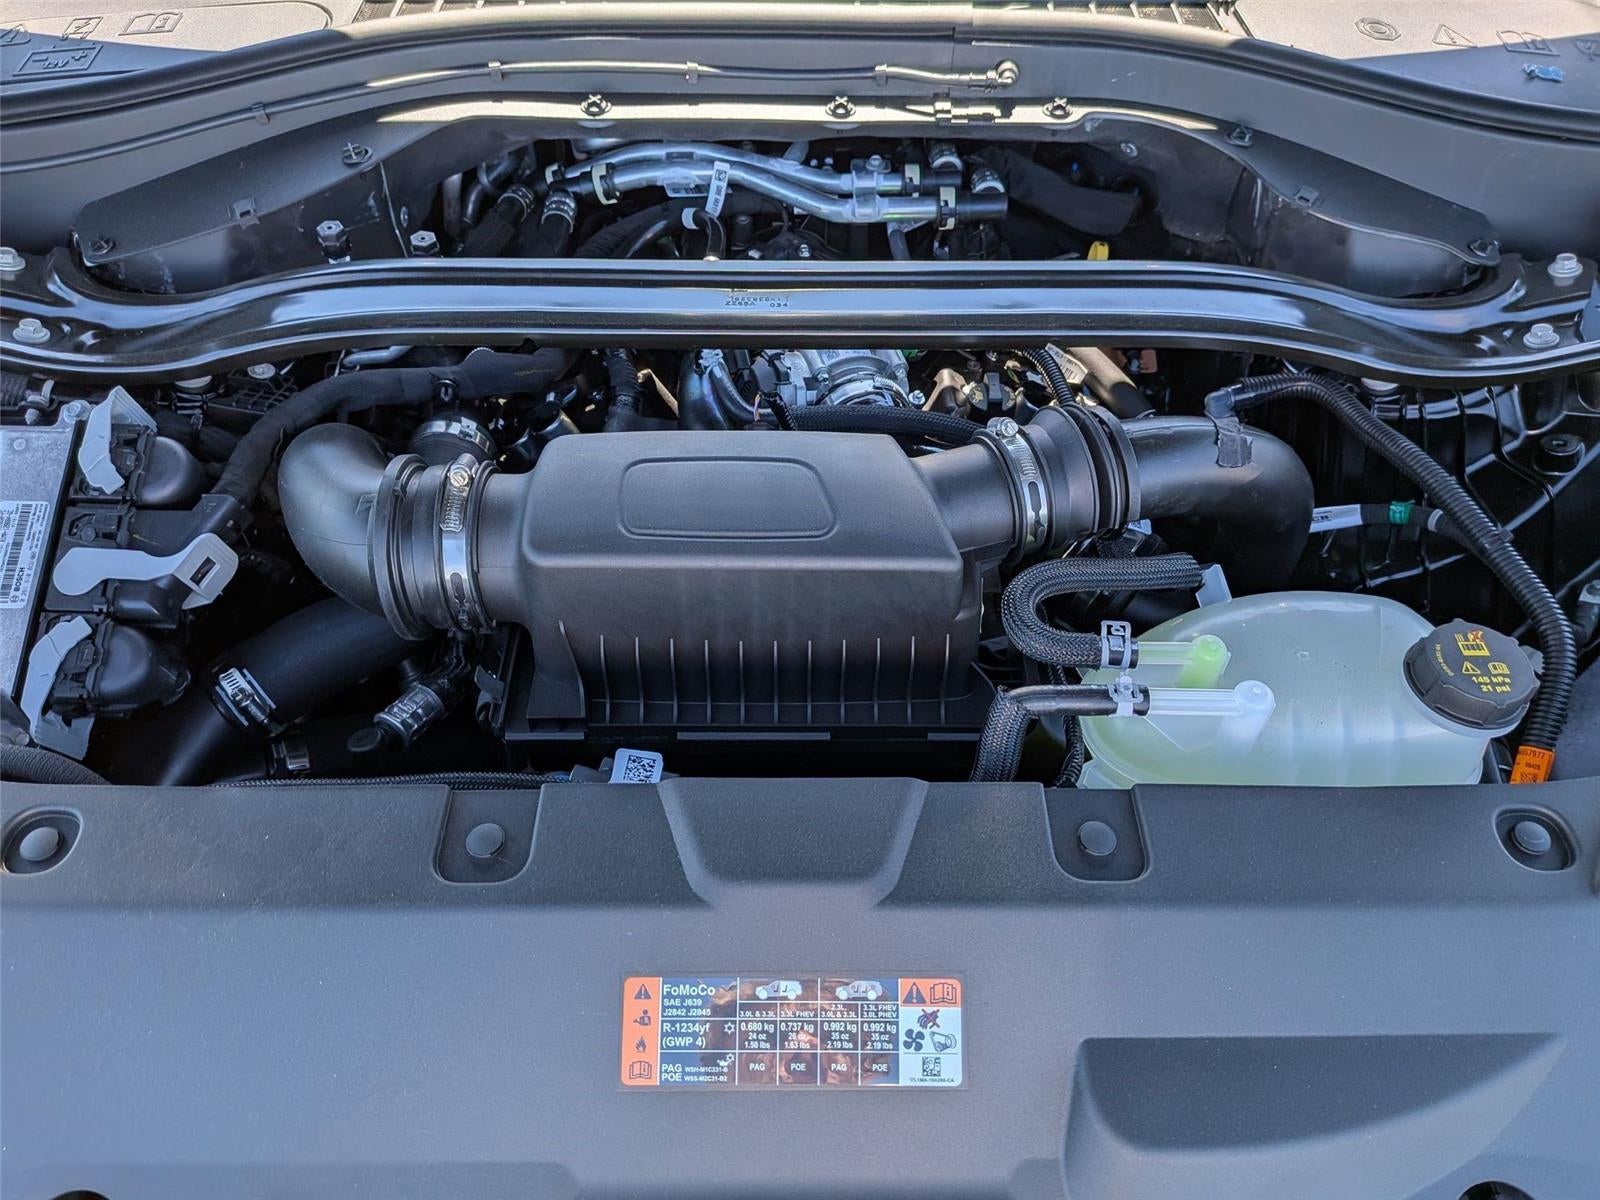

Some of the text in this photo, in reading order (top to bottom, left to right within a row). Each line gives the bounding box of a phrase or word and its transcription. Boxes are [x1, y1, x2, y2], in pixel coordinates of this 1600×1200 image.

[13, 567, 25, 591] BOSCH
[1496, 685, 1511, 693] psi
[663, 984, 716, 996] FoMoCo
[663, 998, 702, 1006] SAE J639
[663, 1008, 711, 1016] J2842 J2845
[662, 1022, 711, 1035] R-1234yf
[740, 1022, 775, 1033] 0.680 kg
[780, 1022, 814, 1033] 0.737 kg
[823, 1022, 857, 1033] 0.992 kg
[863, 1022, 897, 1034] 0.992 kg
[748, 1032, 757, 1040] 24
[788, 1032, 797, 1040] 26
[831, 1032, 840, 1040] 35
[662, 1036, 706, 1049] (GWP 4)
[744, 1041, 770, 1049] 1.50 lbs
[784, 1041, 810, 1049] 1.63 lbs
[826, 1041, 853, 1049] 2.19 lbs
[661, 1064, 683, 1073] PAG
[749, 1062, 765, 1071] PAG
[790, 1063, 806, 1071] POE
[831, 1063, 847, 1071] PAG
[872, 1063, 888, 1071] POE
[661, 1073, 683, 1082] POE
